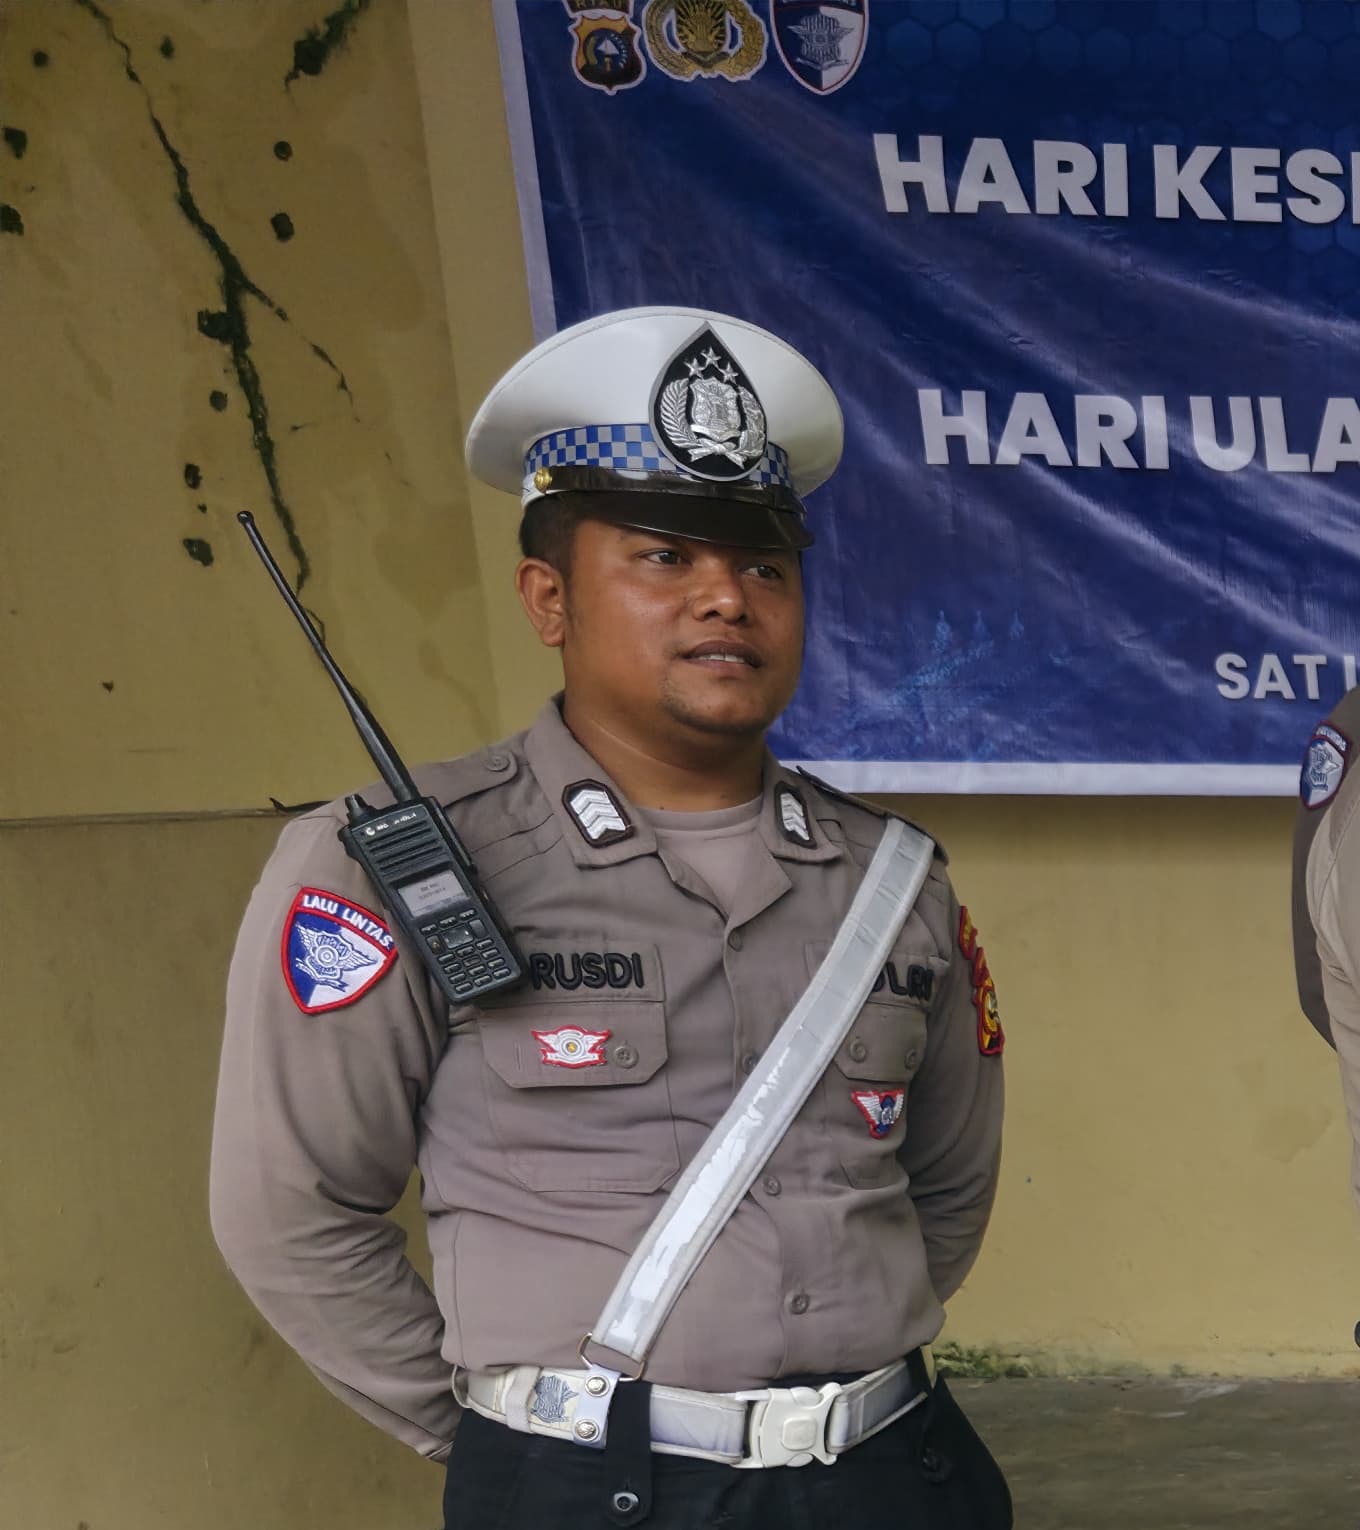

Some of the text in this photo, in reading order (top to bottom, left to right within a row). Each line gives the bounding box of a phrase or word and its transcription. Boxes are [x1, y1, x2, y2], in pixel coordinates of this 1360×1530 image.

[873, 133, 1129, 218] HARI
[917, 389, 1169, 470] HARI
[1214, 653, 1327, 700] SAT
[303, 894, 395, 947] LALU LINTAS
[529, 951, 645, 990] RUSDI
[872, 961, 935, 1000] LRI
